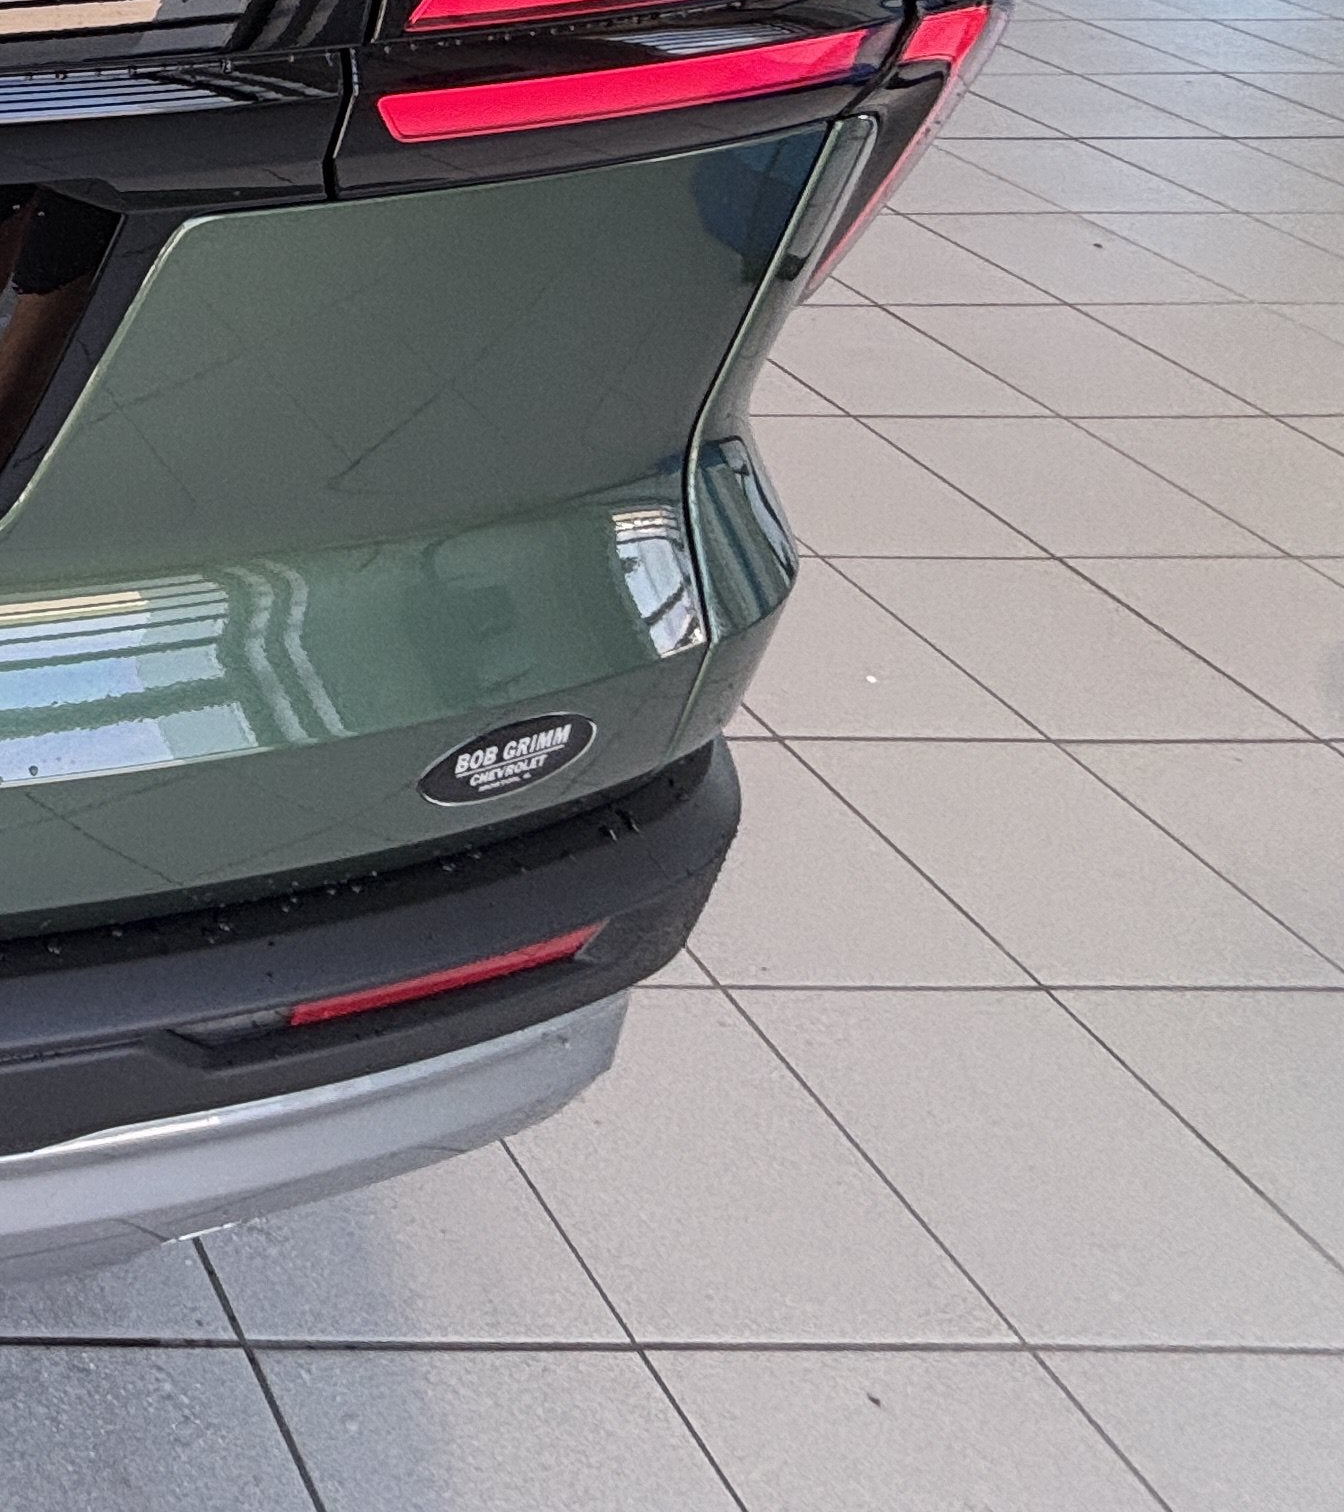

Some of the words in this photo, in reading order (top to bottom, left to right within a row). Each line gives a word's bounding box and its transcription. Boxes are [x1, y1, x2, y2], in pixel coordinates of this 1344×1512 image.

[454, 745, 500, 774] BOB
[502, 723, 572, 761] GRIMM
[469, 753, 549, 787] CHEVROLET
